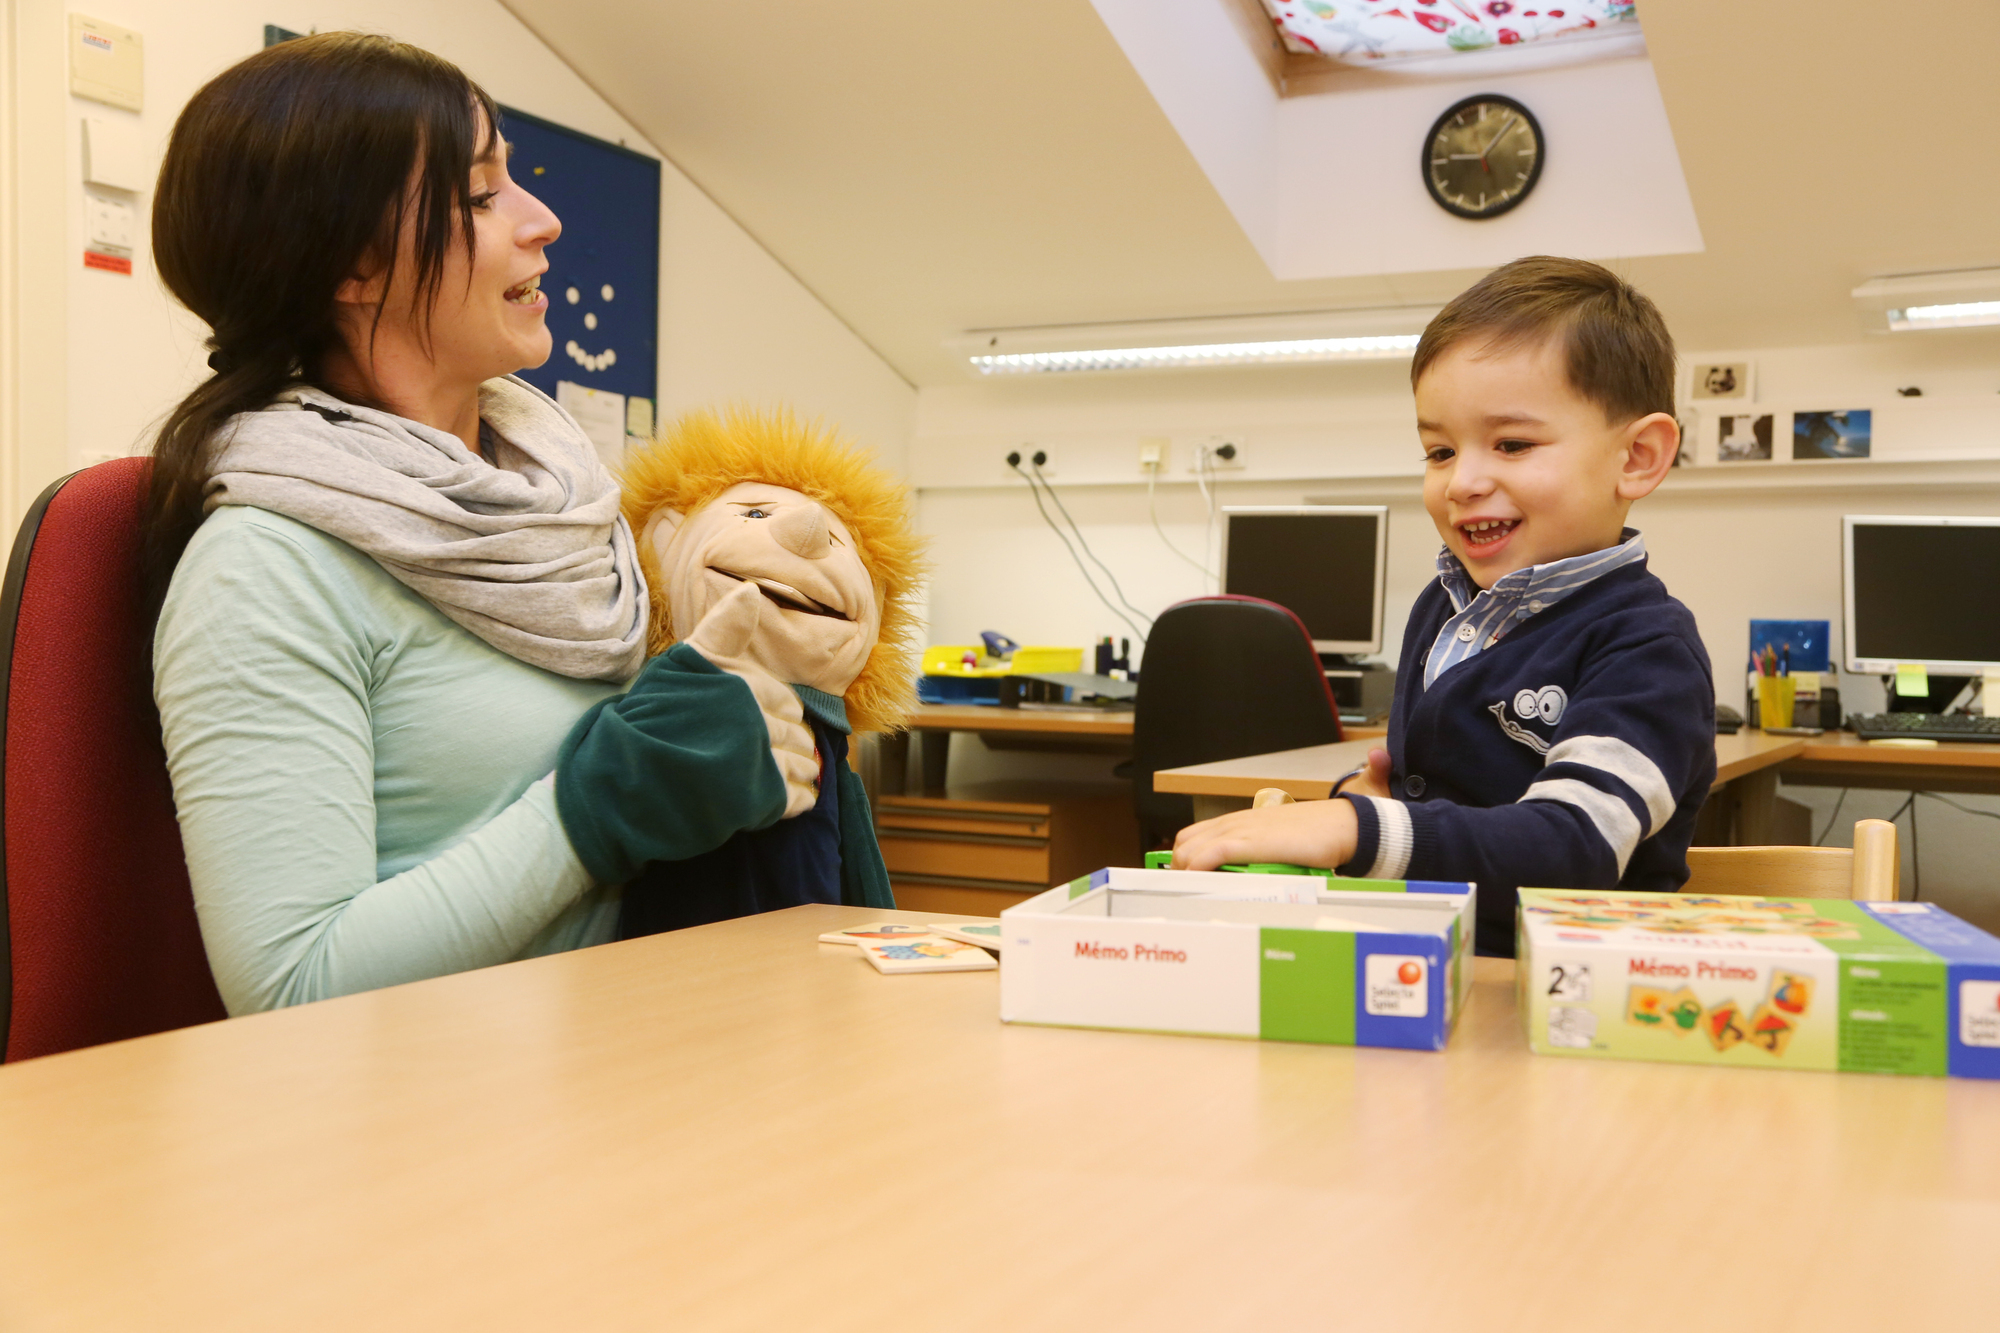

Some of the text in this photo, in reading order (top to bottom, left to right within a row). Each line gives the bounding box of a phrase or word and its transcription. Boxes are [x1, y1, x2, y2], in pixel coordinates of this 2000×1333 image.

[1075, 940, 1187, 963] Mémo Primo
[1628, 957, 1758, 982] Mémo Primo
